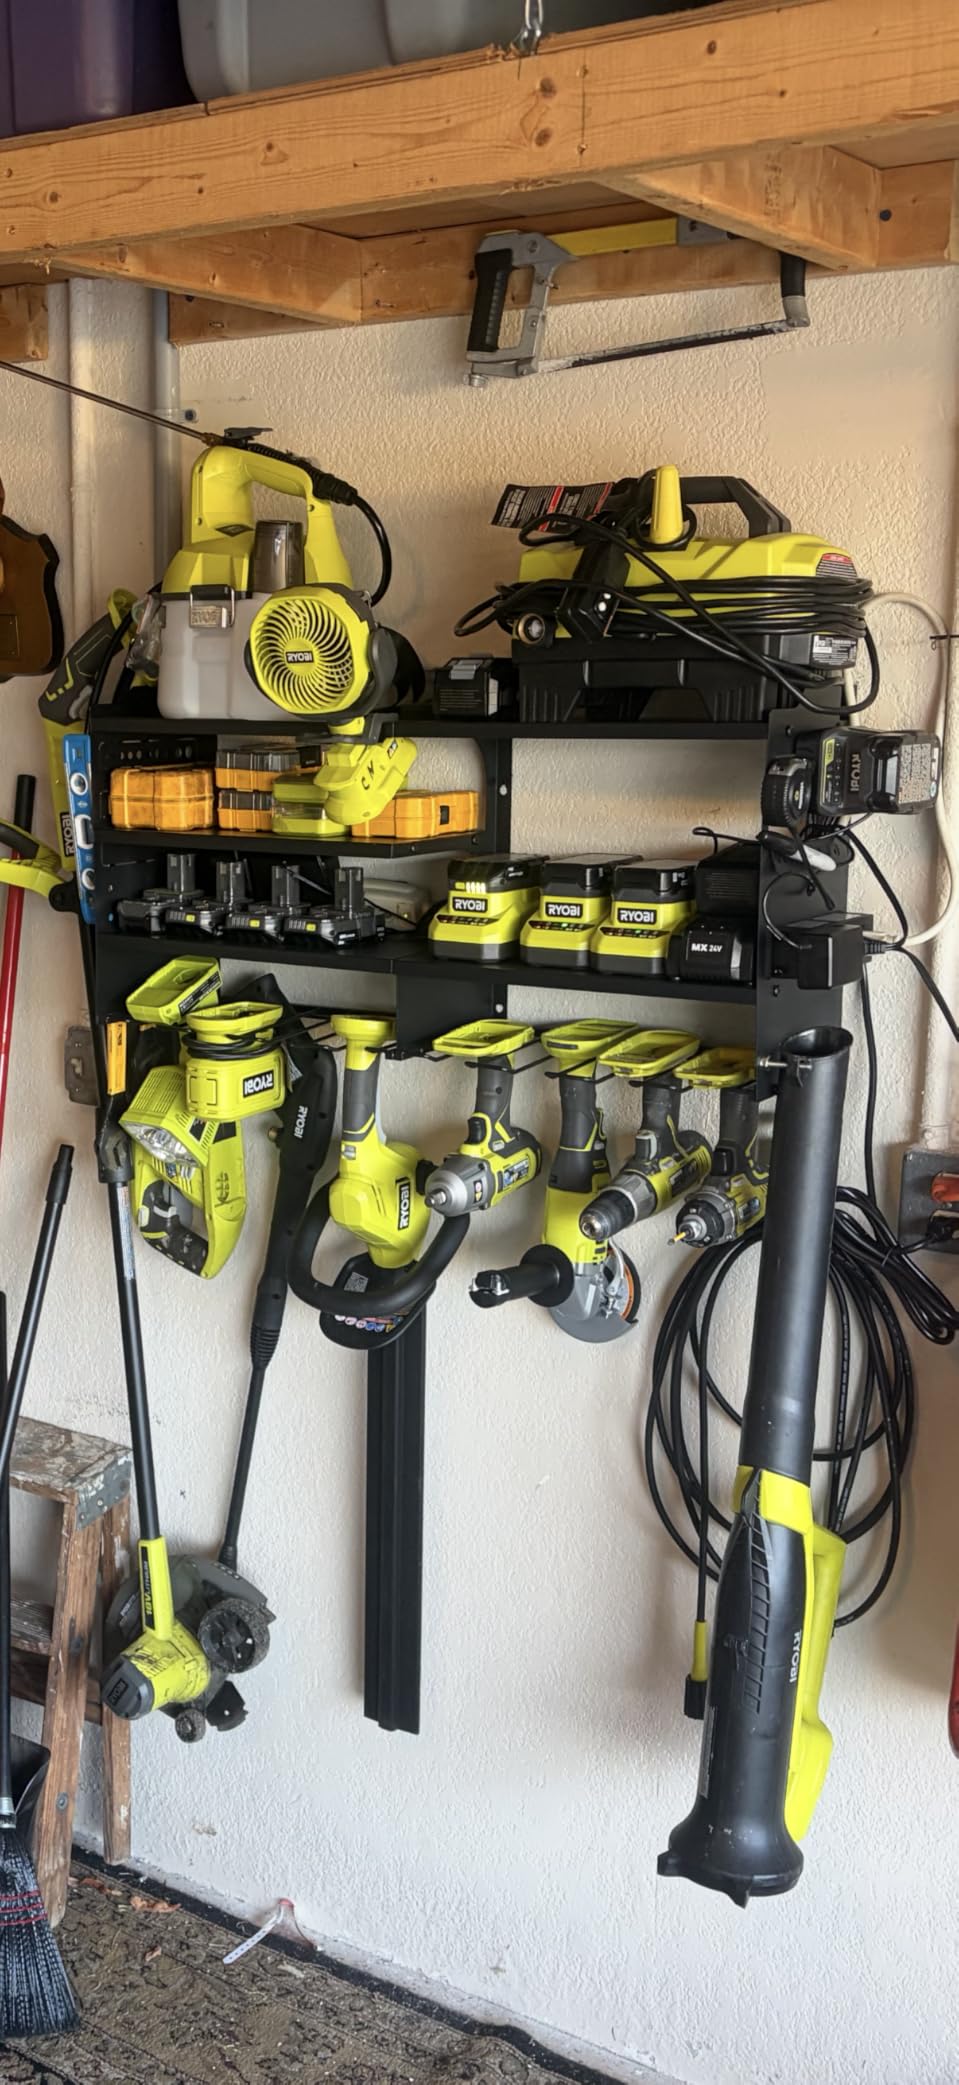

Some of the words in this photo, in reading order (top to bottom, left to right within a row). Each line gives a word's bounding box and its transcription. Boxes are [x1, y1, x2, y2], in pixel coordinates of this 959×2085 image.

[287, 652, 313, 662] RYOBI
[850, 753, 861, 791] RYOBI
[62, 814, 75, 856] RYOBI
[454, 898, 486, 911] RYOBI
[547, 904, 581, 917] RYOBI
[620, 910, 654, 923] RYOBI
[691, 943, 708, 953] MX
[709, 944, 723, 953] 24V
[244, 1073, 274, 1095] RYOBI
[294, 1105, 308, 1139] RYOBI
[400, 1185, 409, 1228] RYOBI
[789, 1630, 802, 1682] RYOBI
